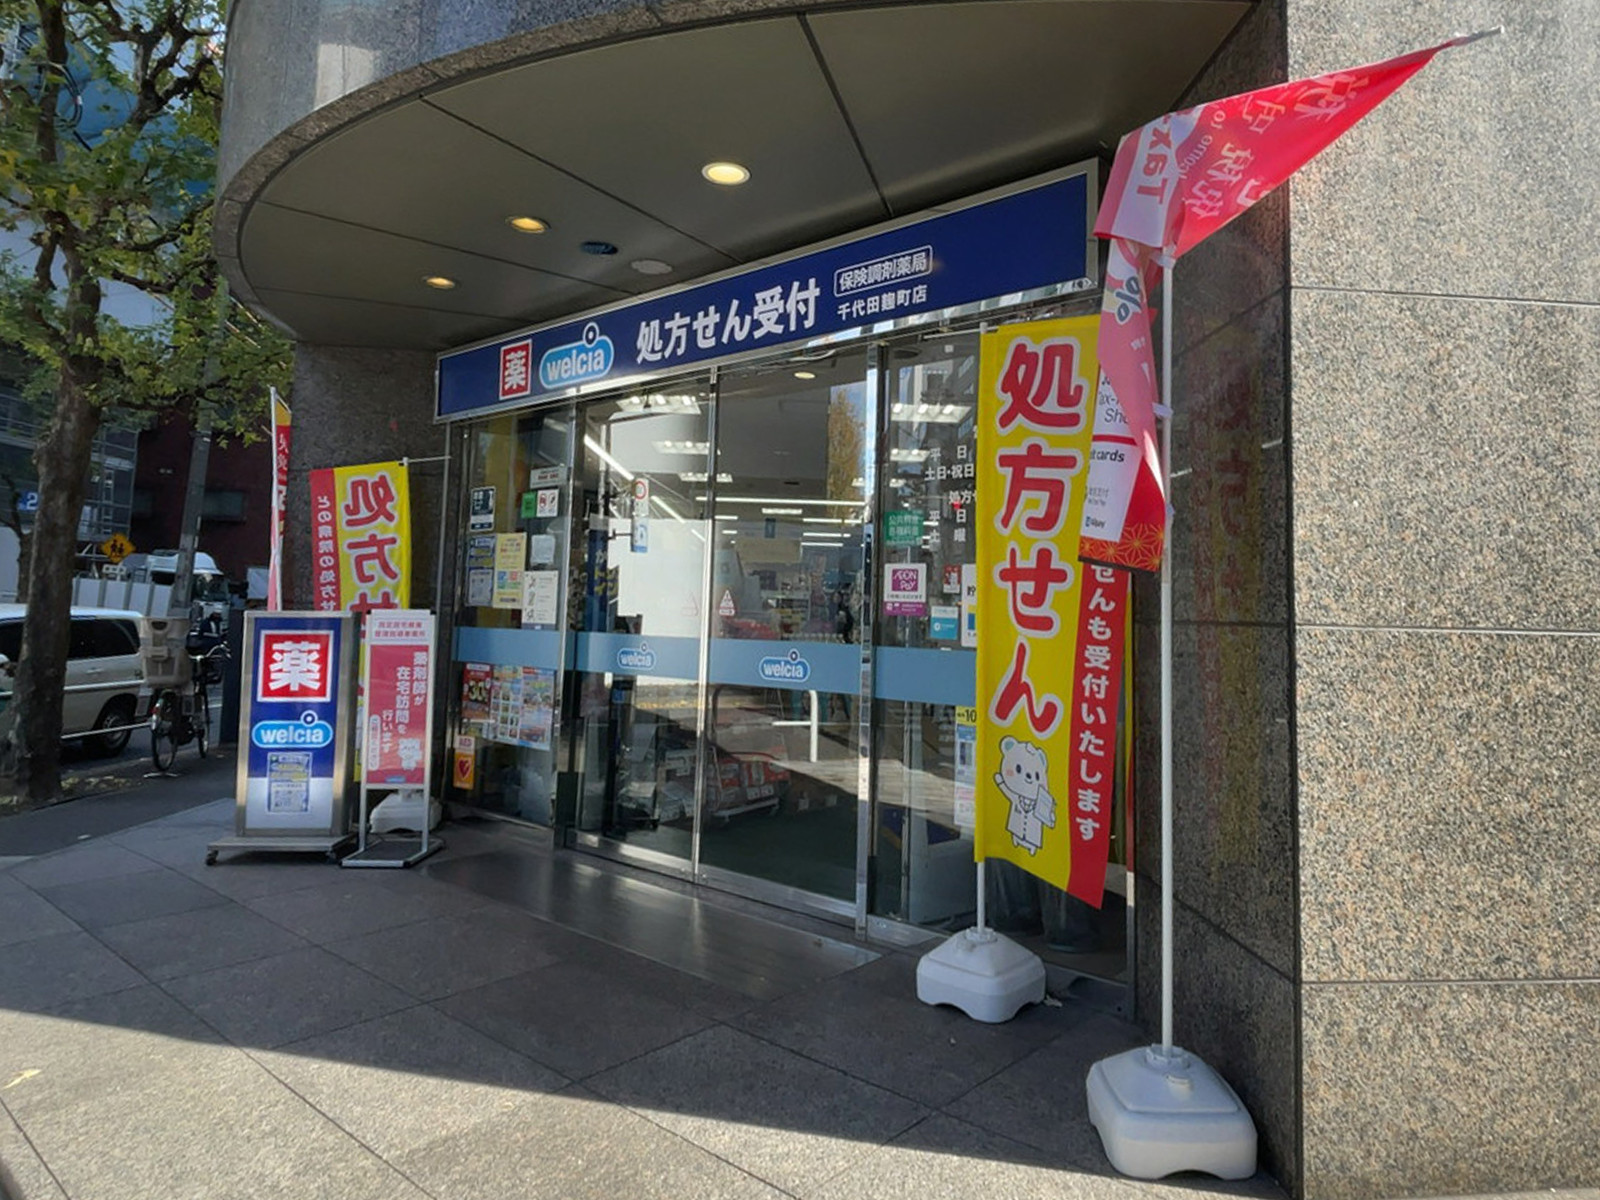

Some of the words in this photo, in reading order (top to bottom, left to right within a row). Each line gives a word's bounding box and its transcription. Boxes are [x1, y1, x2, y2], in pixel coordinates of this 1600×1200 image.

[839, 252, 927, 291] 保険調剤薬局
[636, 279, 821, 364] 処方せん受付
[505, 348, 529, 392] 薬
[546, 346, 606, 384] welcia
[995, 342, 1085, 734] 処方せん
[268, 641, 321, 691] 薬
[412, 651, 428, 706] 薬剤師が
[620, 651, 652, 667] welcia
[763, 658, 804, 678] welcia
[395, 666, 411, 734] 在宅訪問を
[260, 725, 324, 744] welcia
[382, 710, 394, 753] 行います
